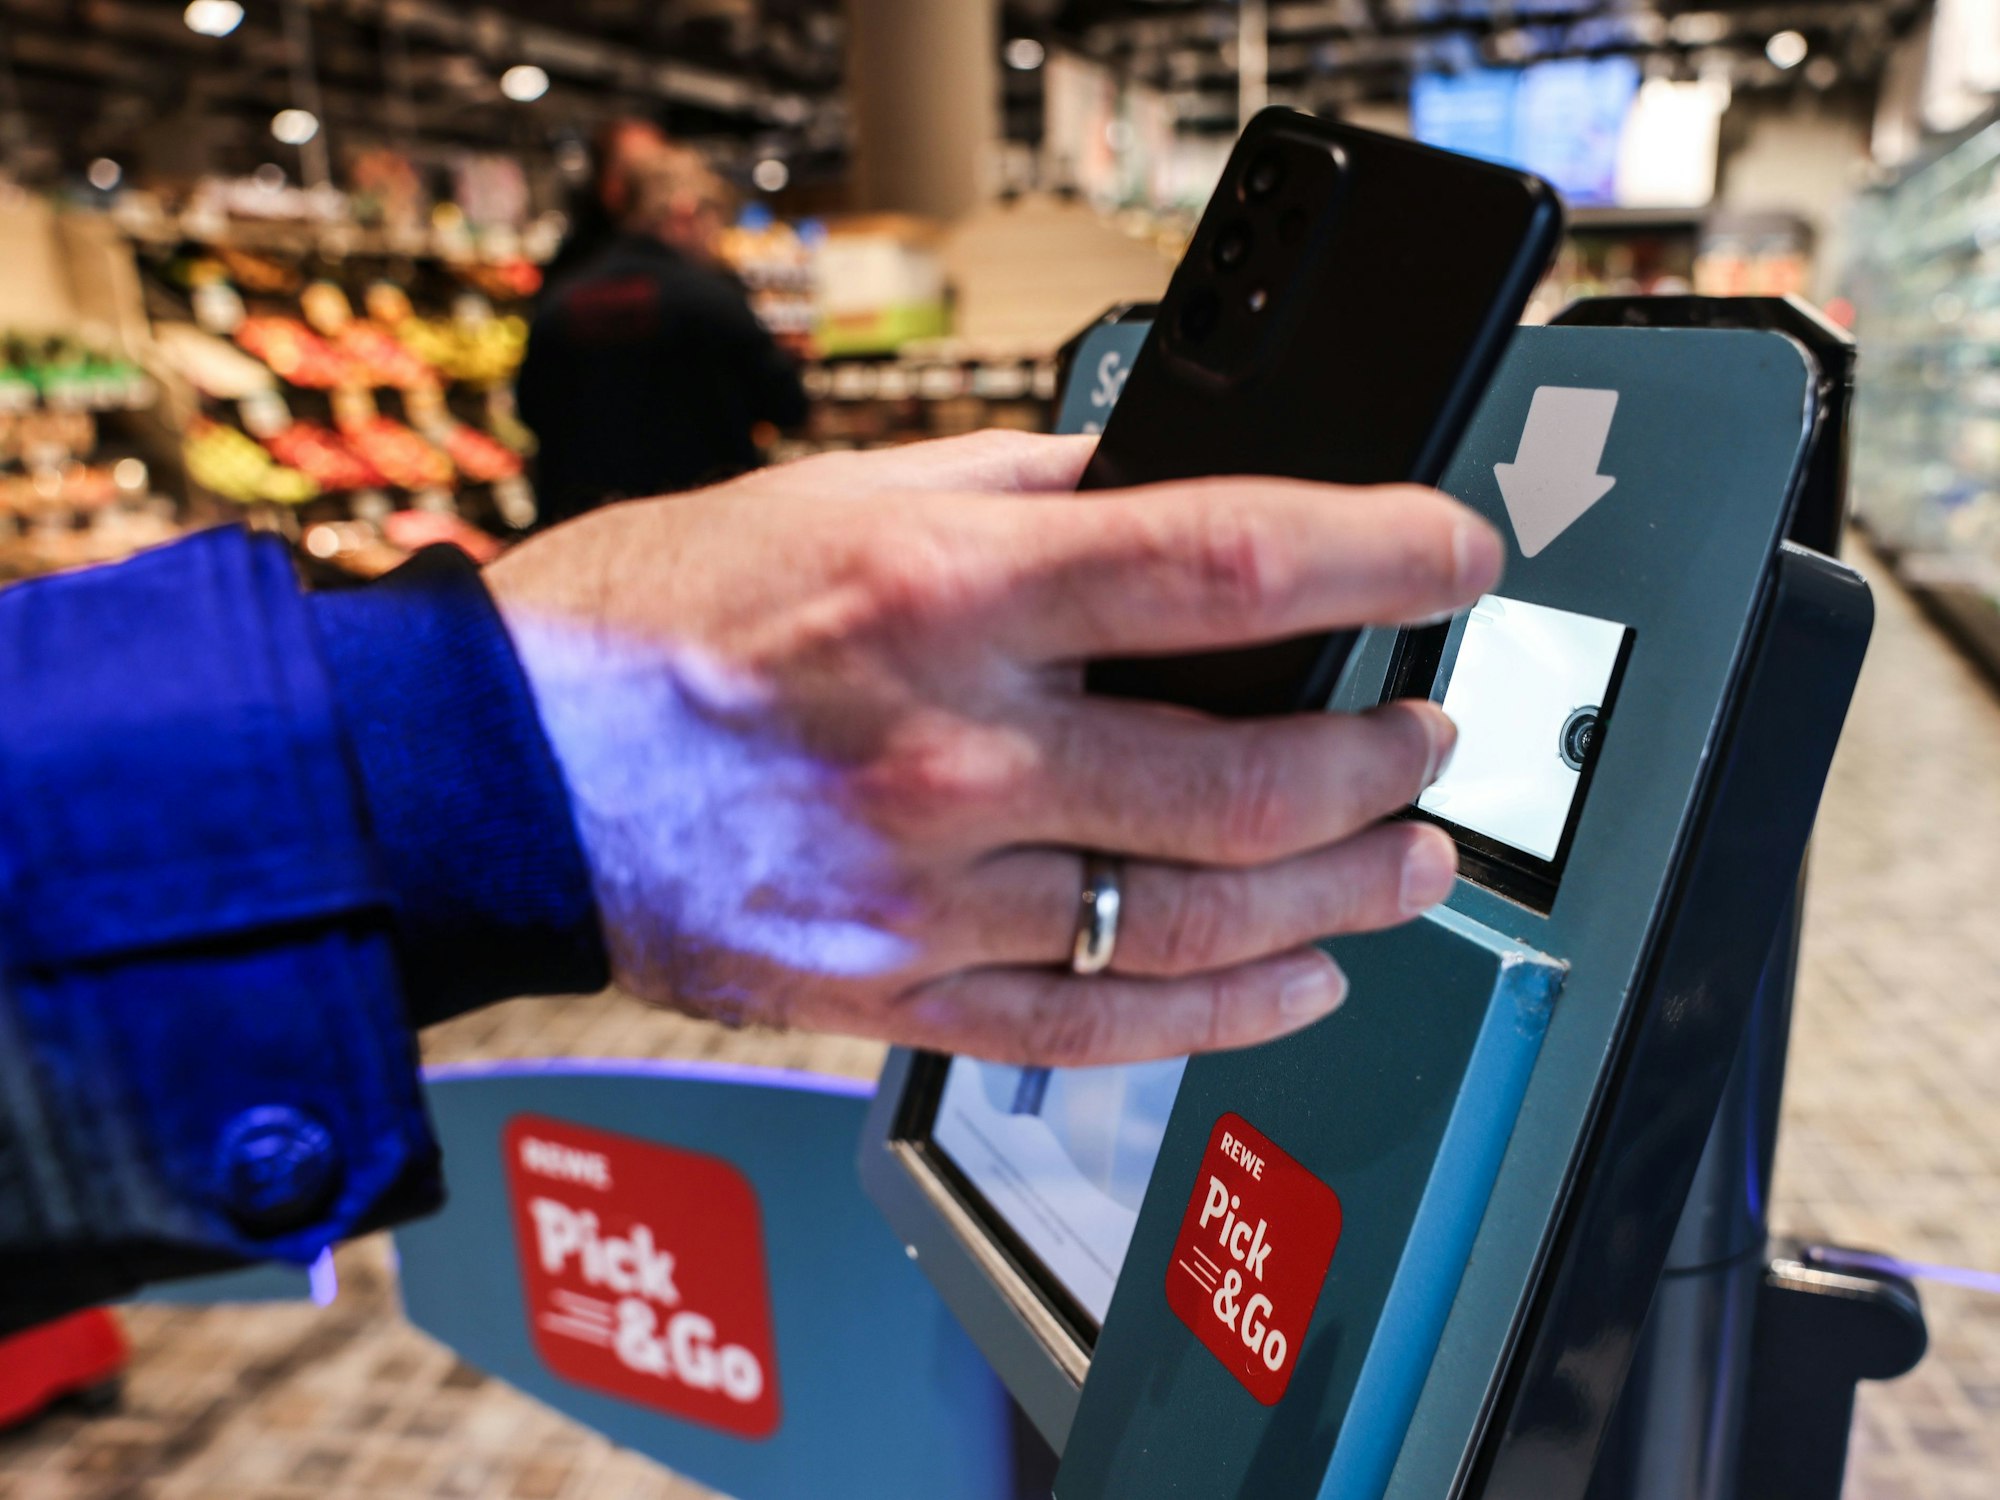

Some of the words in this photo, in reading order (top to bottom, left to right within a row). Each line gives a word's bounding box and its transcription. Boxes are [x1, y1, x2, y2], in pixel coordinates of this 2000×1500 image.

[520, 1137, 612, 1190] REWE
[1220, 1132, 1265, 1181] REWE
[530, 1197, 680, 1306] Pick
[1199, 1175, 1272, 1282] Pick
[612, 1297, 763, 1404] &Go
[1213, 1269, 1287, 1371] &Go
